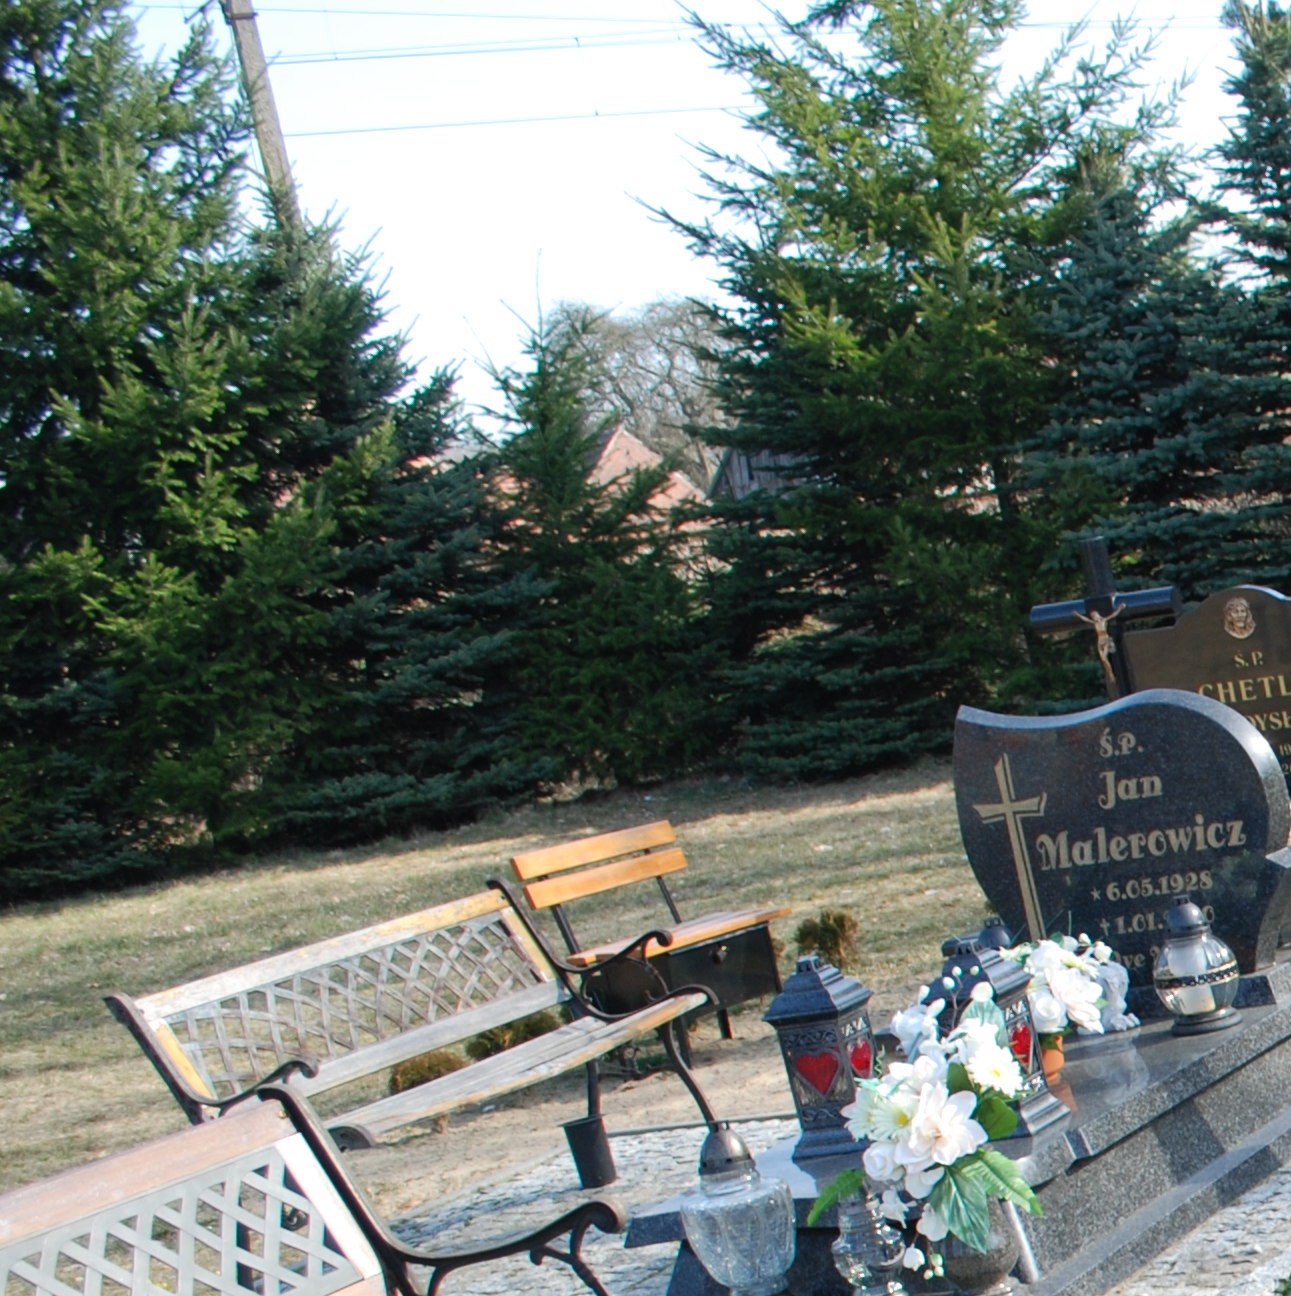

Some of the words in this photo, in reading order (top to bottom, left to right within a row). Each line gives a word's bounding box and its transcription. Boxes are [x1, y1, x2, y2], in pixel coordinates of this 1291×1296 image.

[1098, 770, 1163, 810] Jan
[1036, 813, 1247, 871] Malerowicz
[1105, 870, 1214, 902] 6.05.1928
